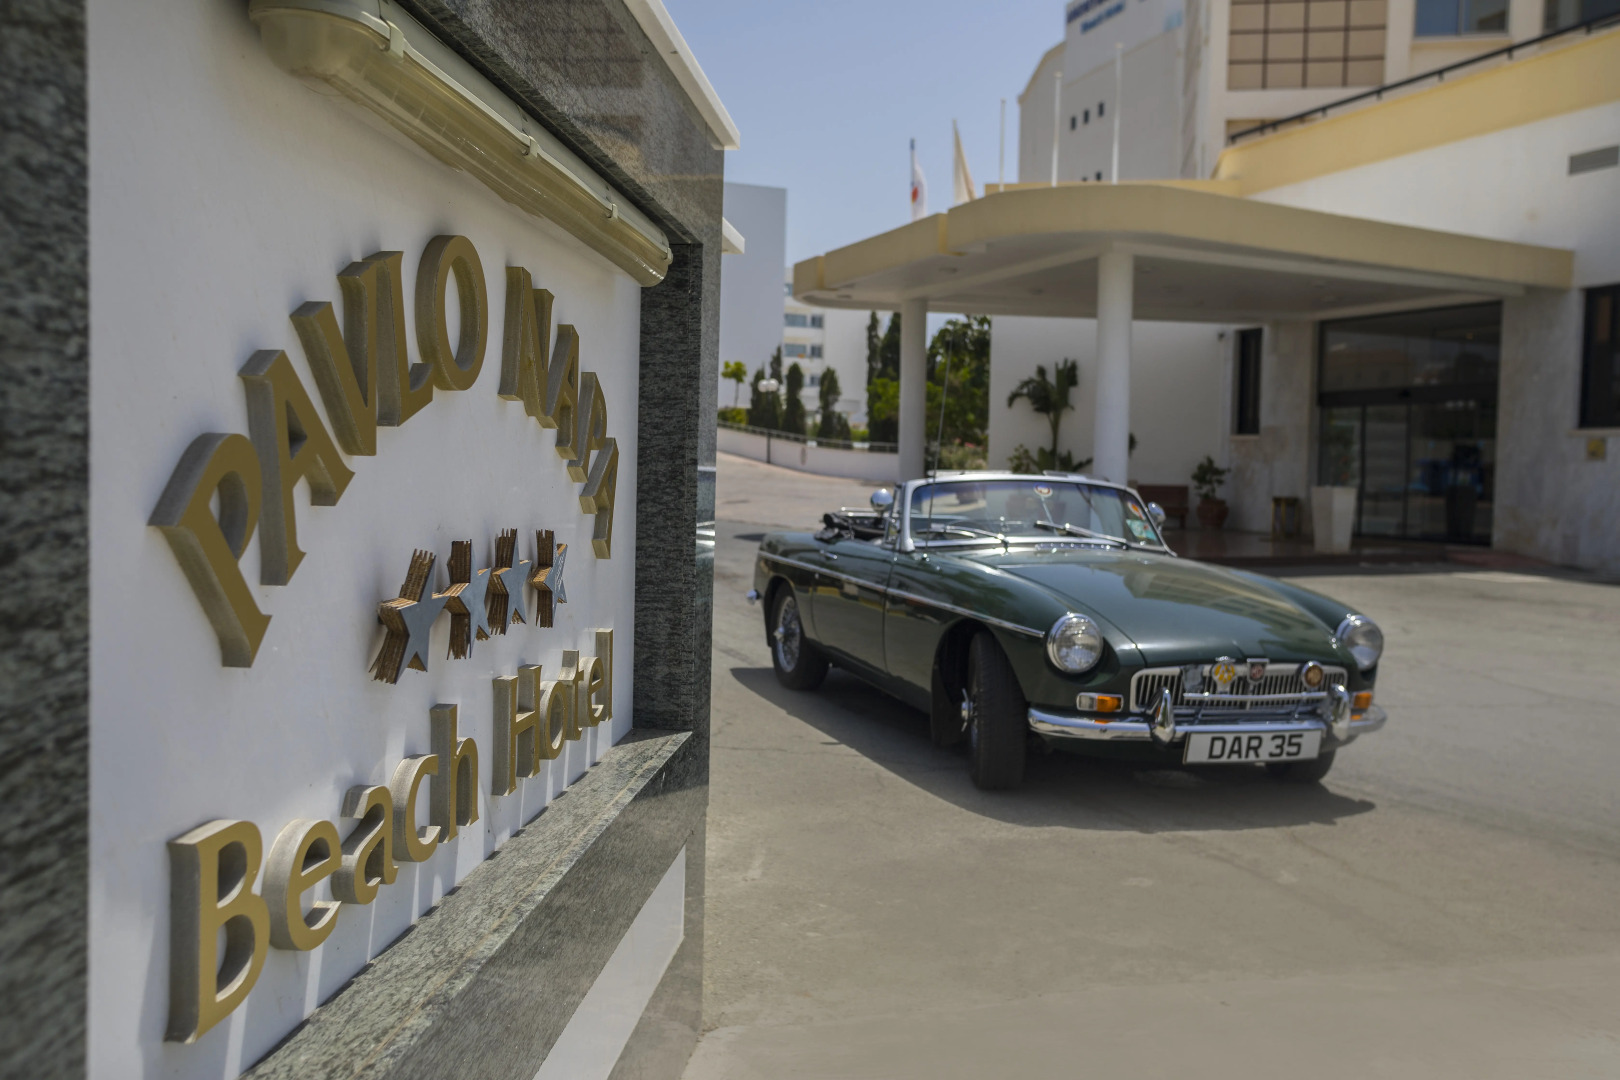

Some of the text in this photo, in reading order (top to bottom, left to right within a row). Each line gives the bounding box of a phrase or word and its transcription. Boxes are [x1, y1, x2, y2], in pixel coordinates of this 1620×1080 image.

[148, 235, 619, 668] PAVLO NAPA
[164, 627, 613, 1044] Beach Hotel
[1208, 734, 1303, 760] DAR 35
